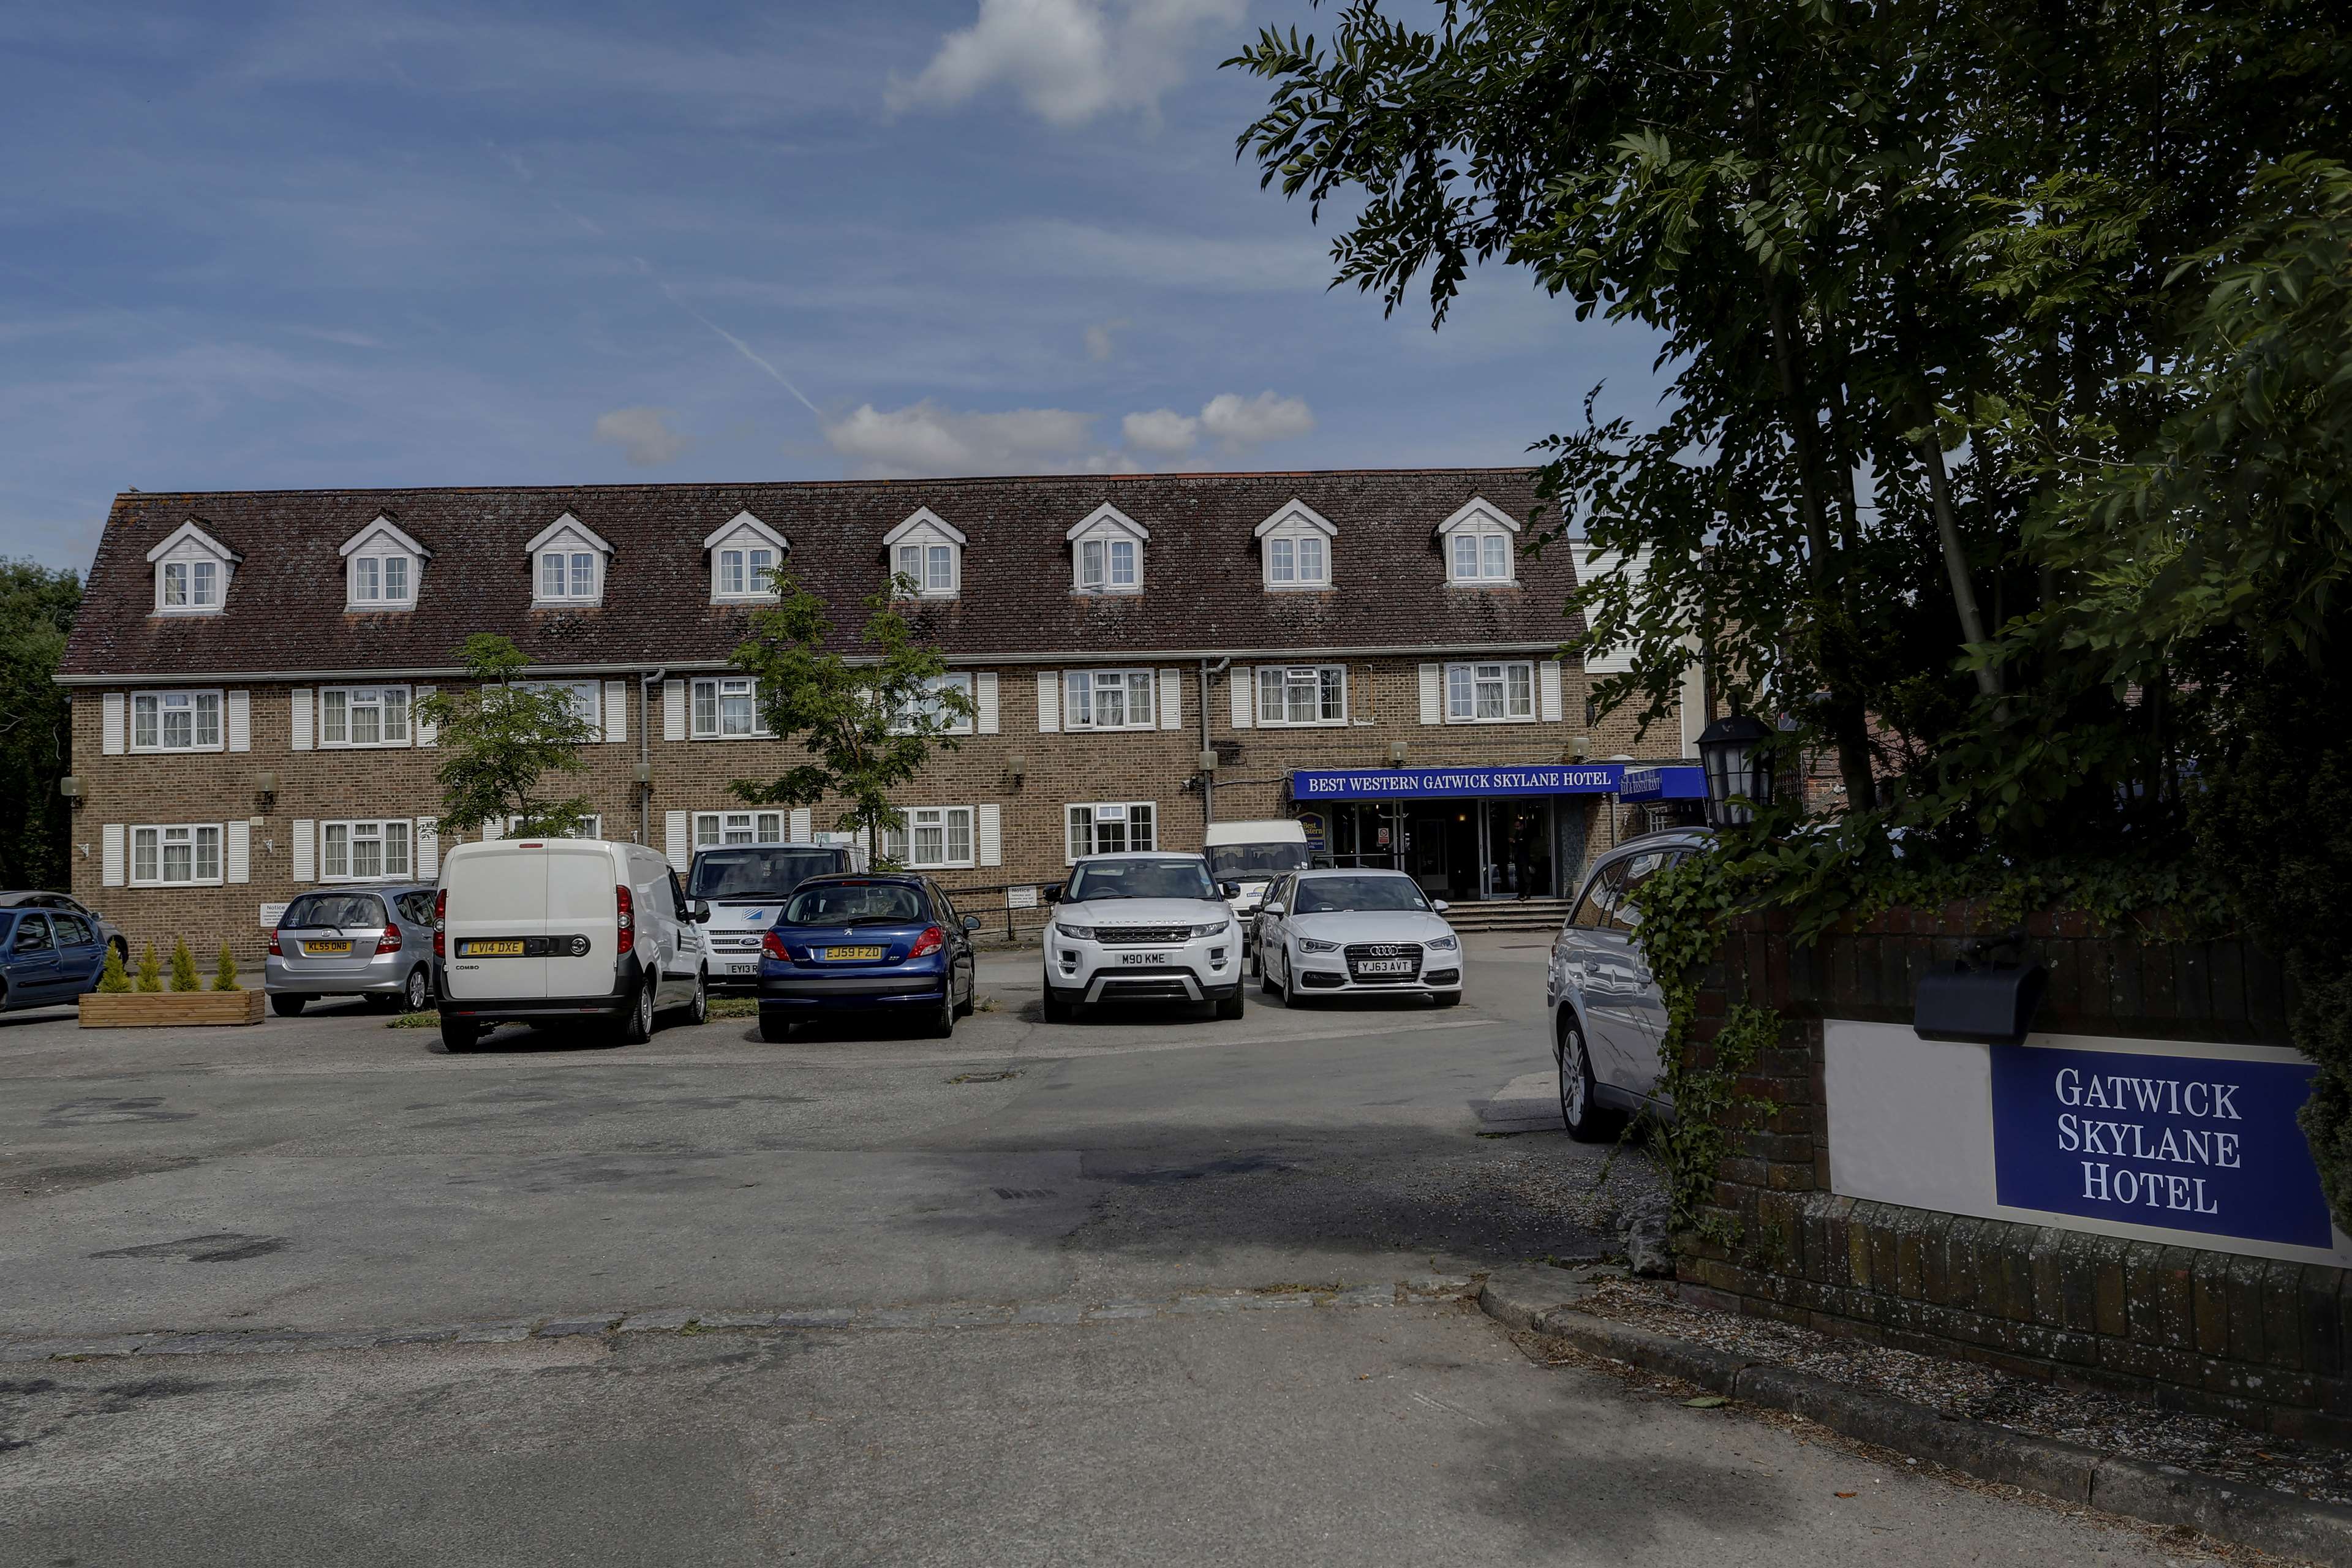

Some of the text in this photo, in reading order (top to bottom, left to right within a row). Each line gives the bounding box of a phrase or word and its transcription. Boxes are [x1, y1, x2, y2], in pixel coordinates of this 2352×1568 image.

[1309, 772, 1611, 792] BEST WESTERN GATWICK SKYLANE HOTEL
[1621, 777, 1660, 795] BAR & RESTAURANT
[471, 943, 519, 953] LV14 DXE
[827, 947, 879, 958] EJ59 FZD
[1122, 954, 1165, 963] M90 KME
[1362, 962, 1408, 971] YJ63 AVT
[2056, 1068, 2242, 1120] GATWICK
[2058, 1114, 2241, 1168] SKYLANE
[2081, 1161, 2218, 1214] HOTEL
